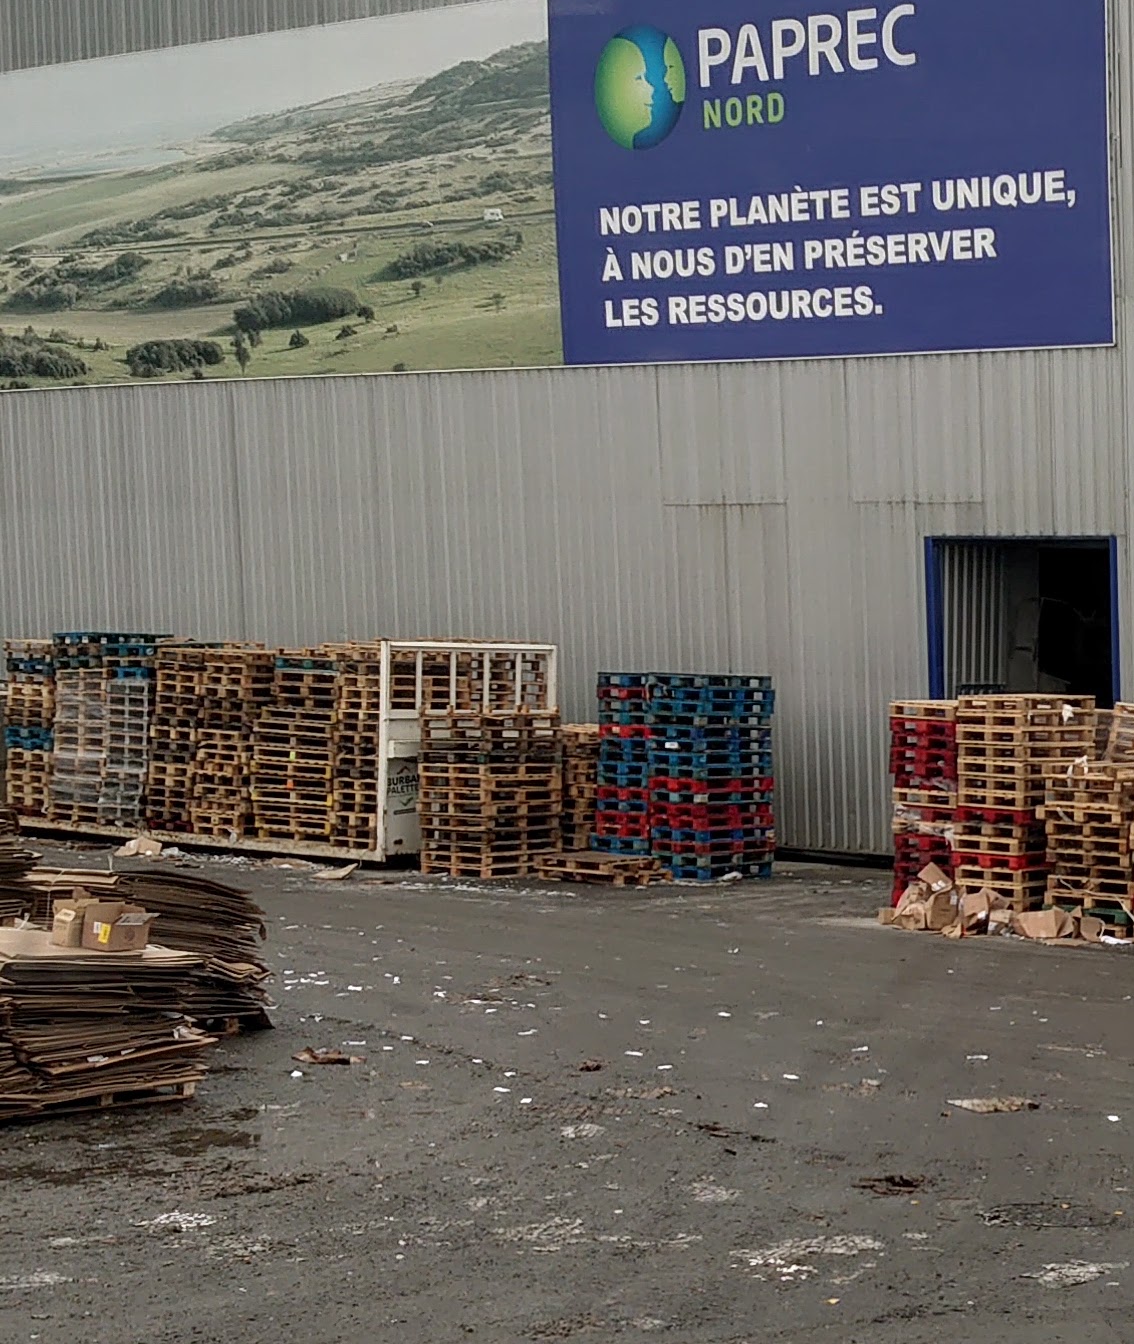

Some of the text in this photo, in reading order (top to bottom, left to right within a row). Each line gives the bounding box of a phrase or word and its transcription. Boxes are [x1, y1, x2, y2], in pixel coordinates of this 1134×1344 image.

[698, 4, 916, 88] PAPREC
[703, 92, 785, 129] NORD
[600, 170, 1076, 235] NOTRE PLANÈTE EST UNIQUE,
[602, 230, 997, 281] À NOUS D’EN PRÉSERVER
[605, 286, 883, 327] LES RESSOURCES.
